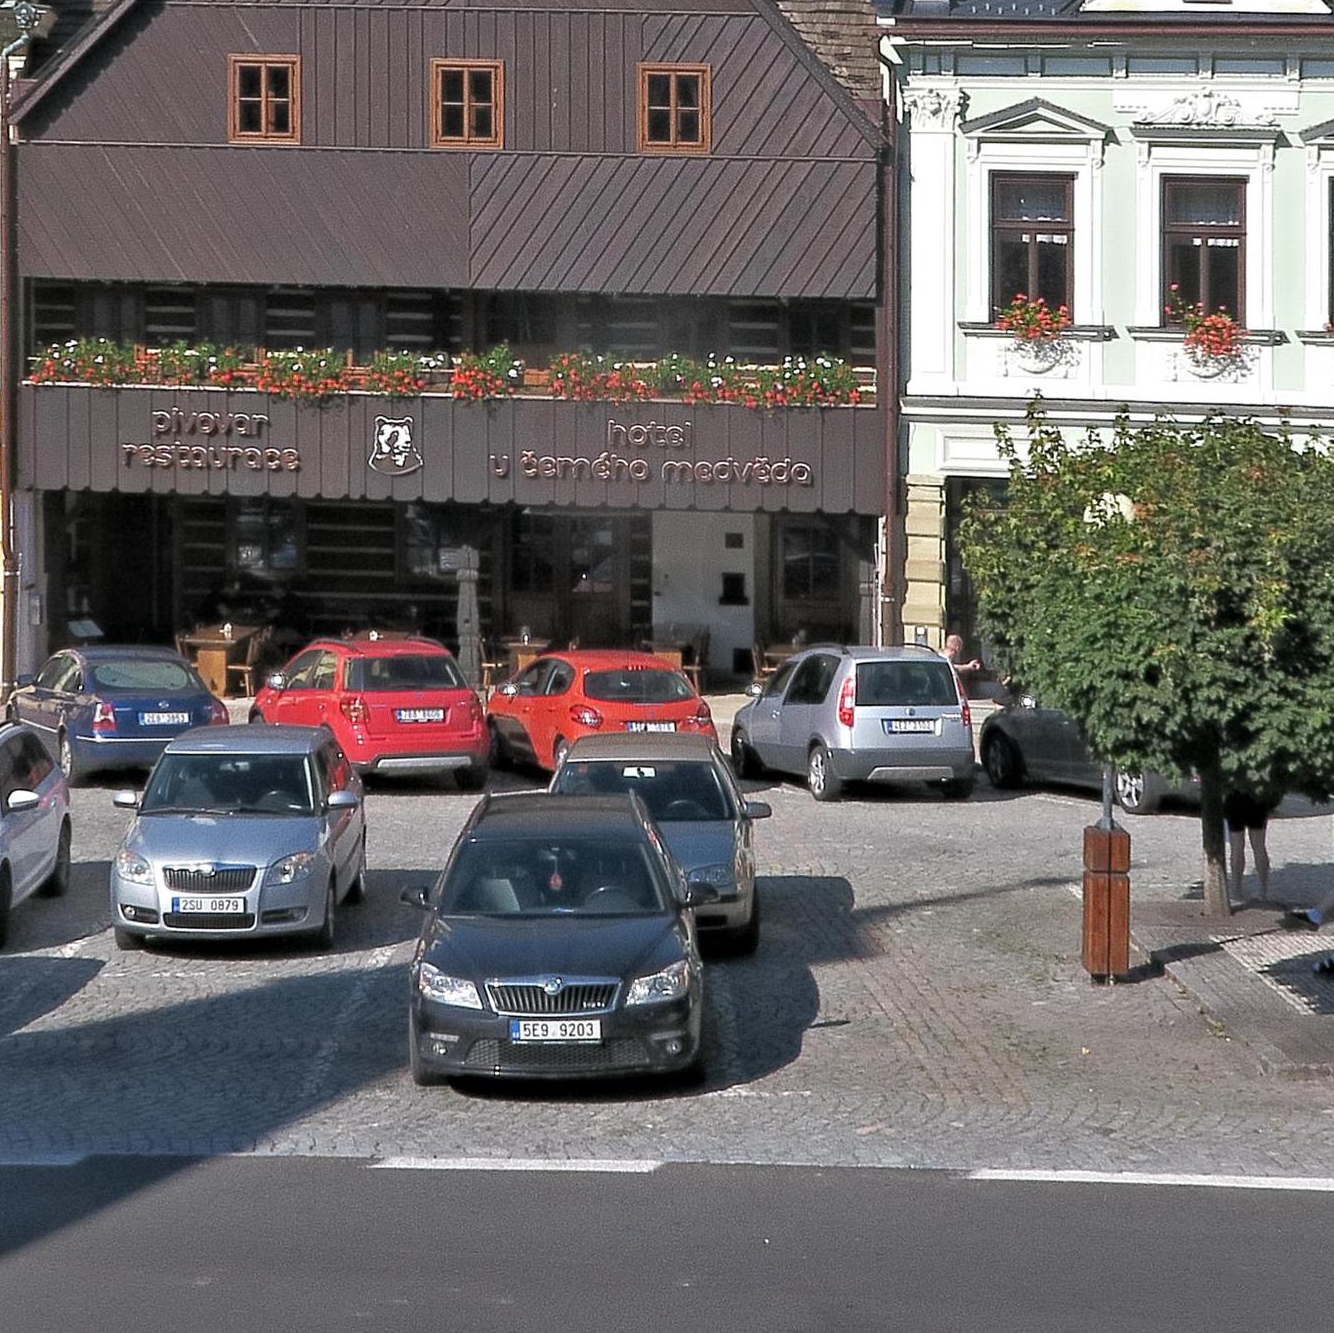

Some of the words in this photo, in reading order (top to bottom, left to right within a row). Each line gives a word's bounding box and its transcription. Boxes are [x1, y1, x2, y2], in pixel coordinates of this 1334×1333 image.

[152, 406, 270, 437] pivovar
[607, 419, 692, 447] hotel
[121, 441, 301, 471] restaurace
[488, 455, 510, 477] u
[519, 450, 650, 481] černého
[661, 456, 813, 485] medvěda
[182, 899, 202, 910] 2SU
[211, 899, 239, 911] 0879
[523, 1023, 549, 1036] 5E9
[560, 1023, 594, 1036] 9203
